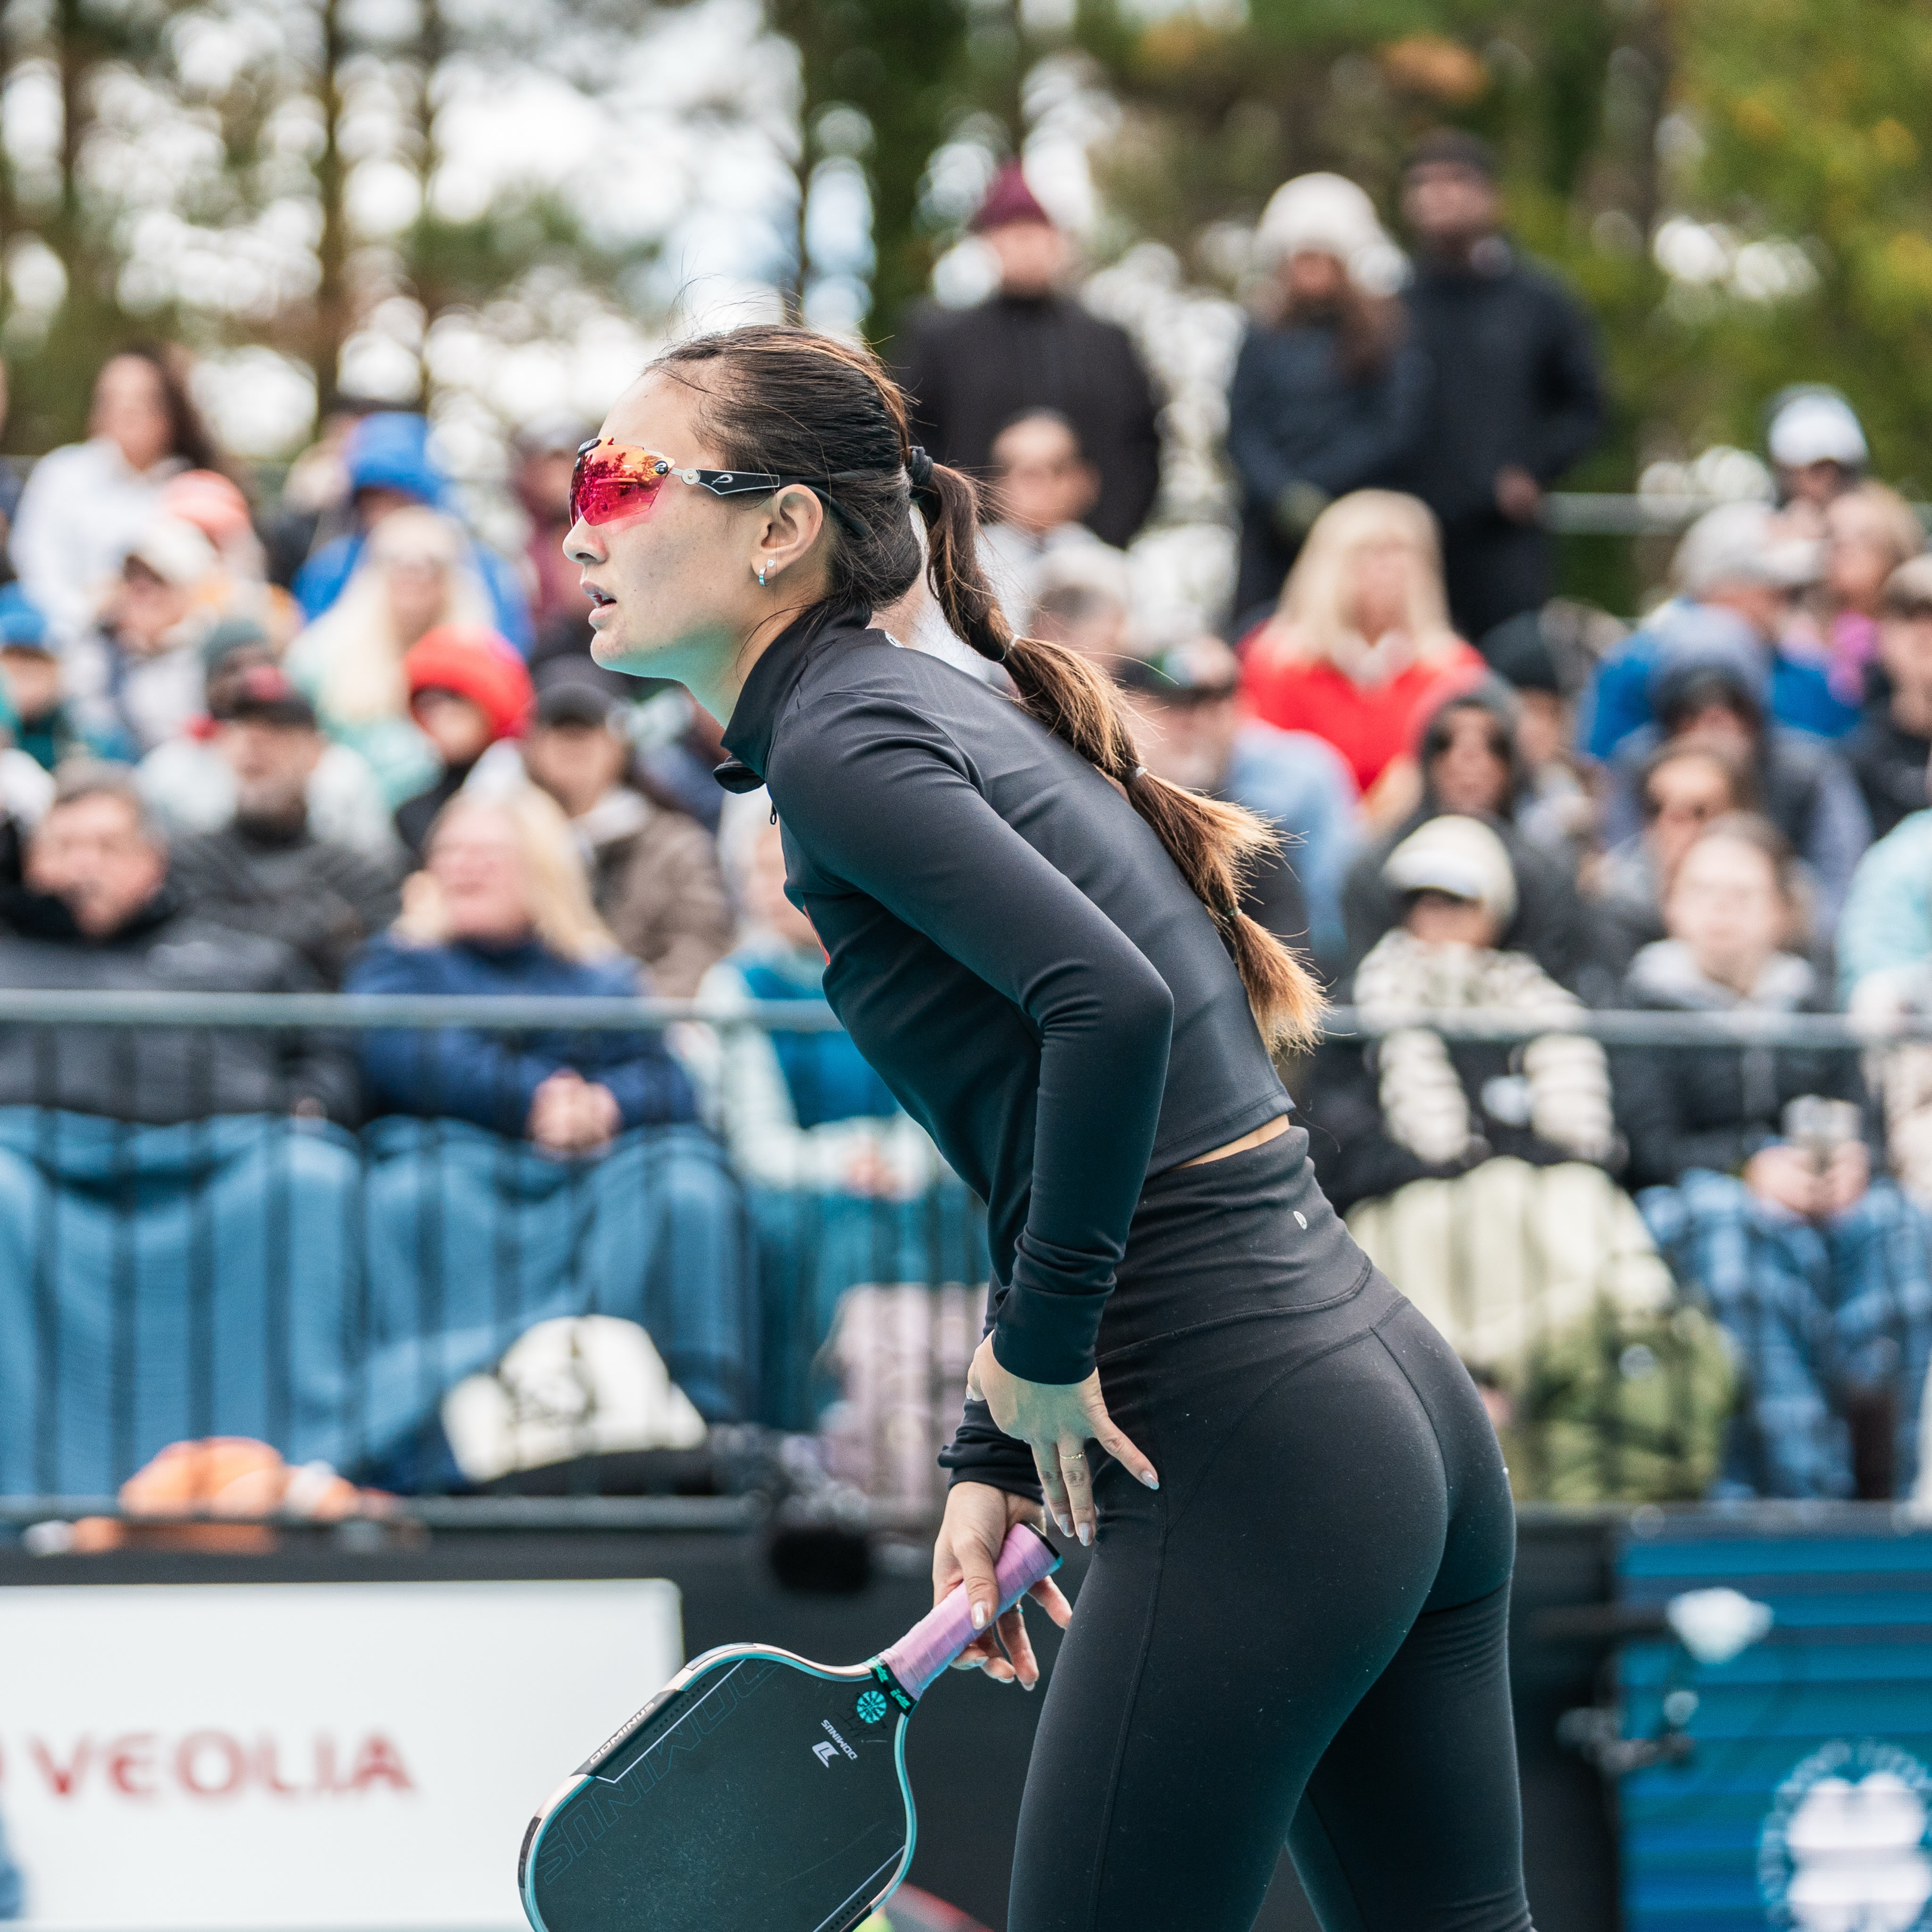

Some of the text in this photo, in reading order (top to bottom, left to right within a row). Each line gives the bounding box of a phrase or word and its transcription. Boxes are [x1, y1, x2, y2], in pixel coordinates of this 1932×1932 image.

[589, 1701, 655, 1764] DOMINUS
[820, 1719, 858, 1760] DOMINUS
[30, 1730, 416, 1803] VEOLIA
